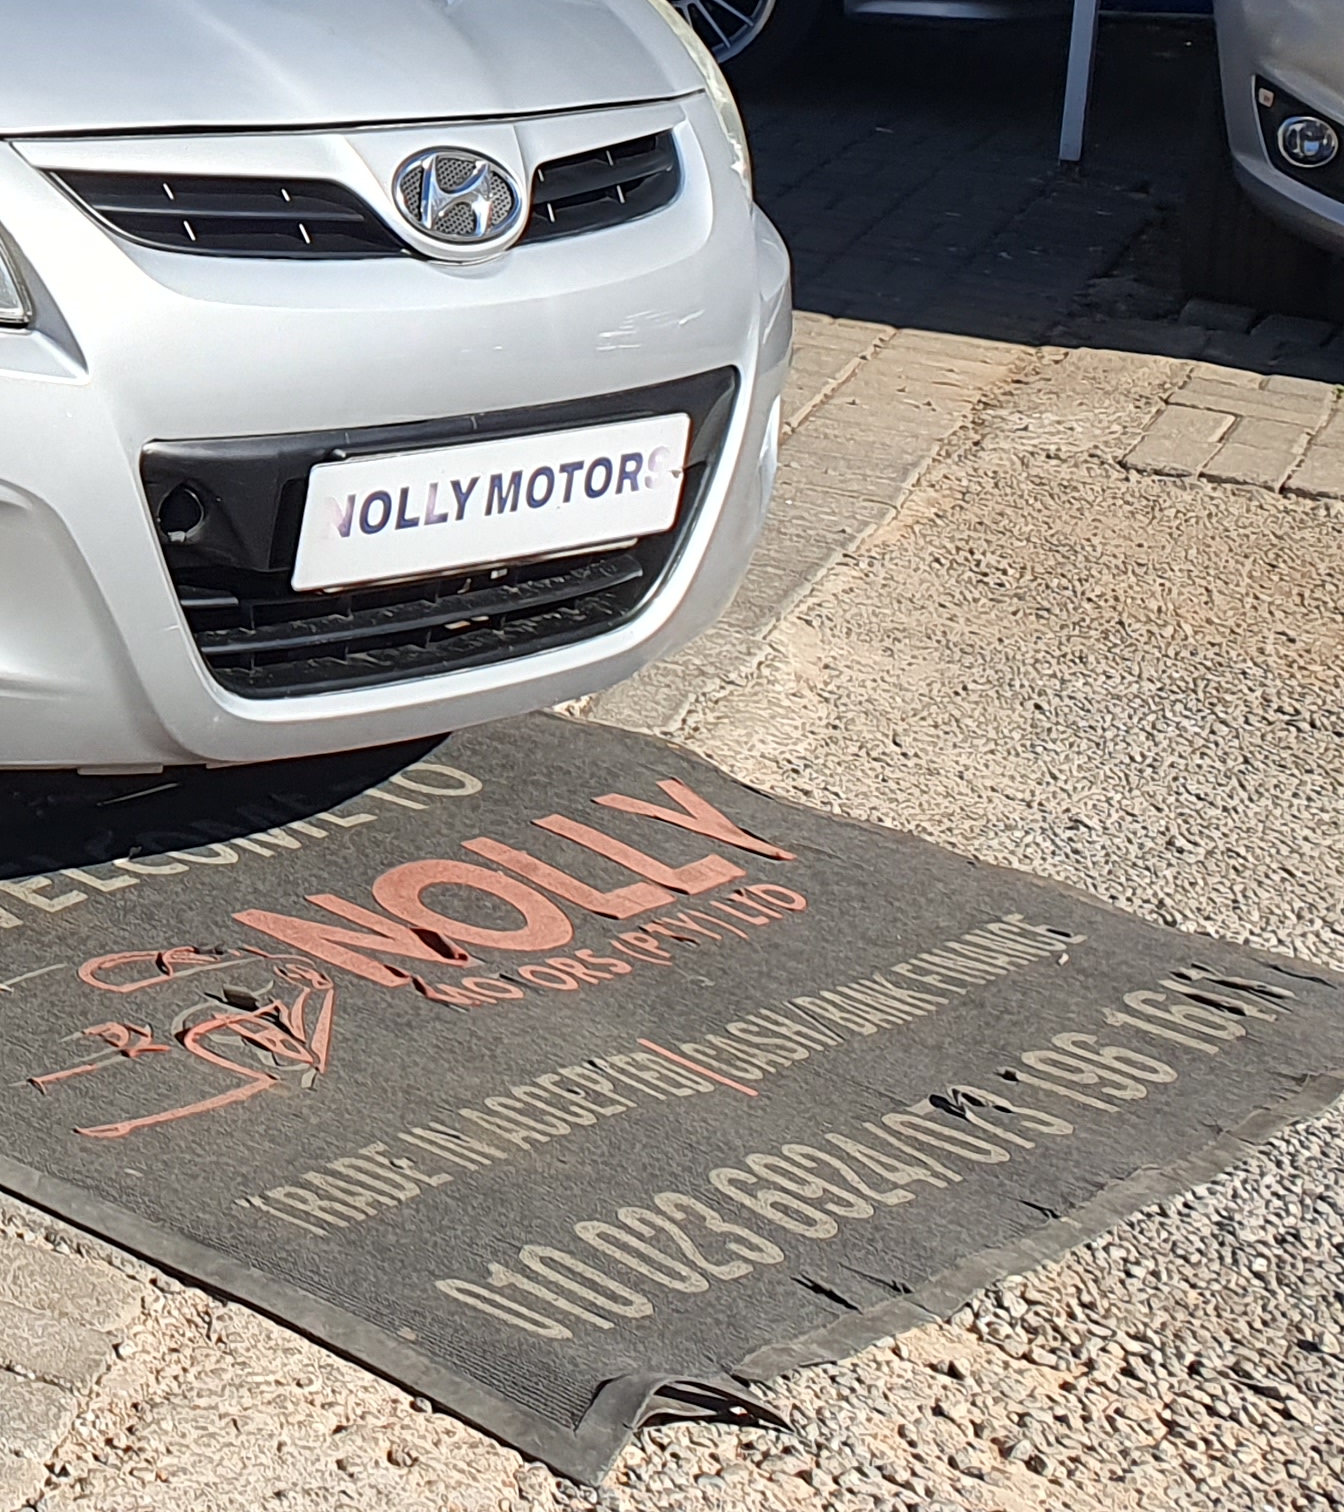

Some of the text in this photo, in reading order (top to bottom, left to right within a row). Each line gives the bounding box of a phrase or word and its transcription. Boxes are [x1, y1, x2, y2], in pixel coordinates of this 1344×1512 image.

[331, 445, 670, 539] NOLLY MOTORS
[334, 761, 484, 811] TO
[231, 777, 798, 987] NOLLY
[412, 948, 633, 1008] MOORS
[234, 1140, 454, 1237] TRADE
[398, 1120, 508, 1171] IN
[891, 912, 1089, 996] FINANCE
[434, 1243, 655, 1340] 010
[572, 1190, 786, 1294] 023
[996, 1031, 1179, 1112] 196
